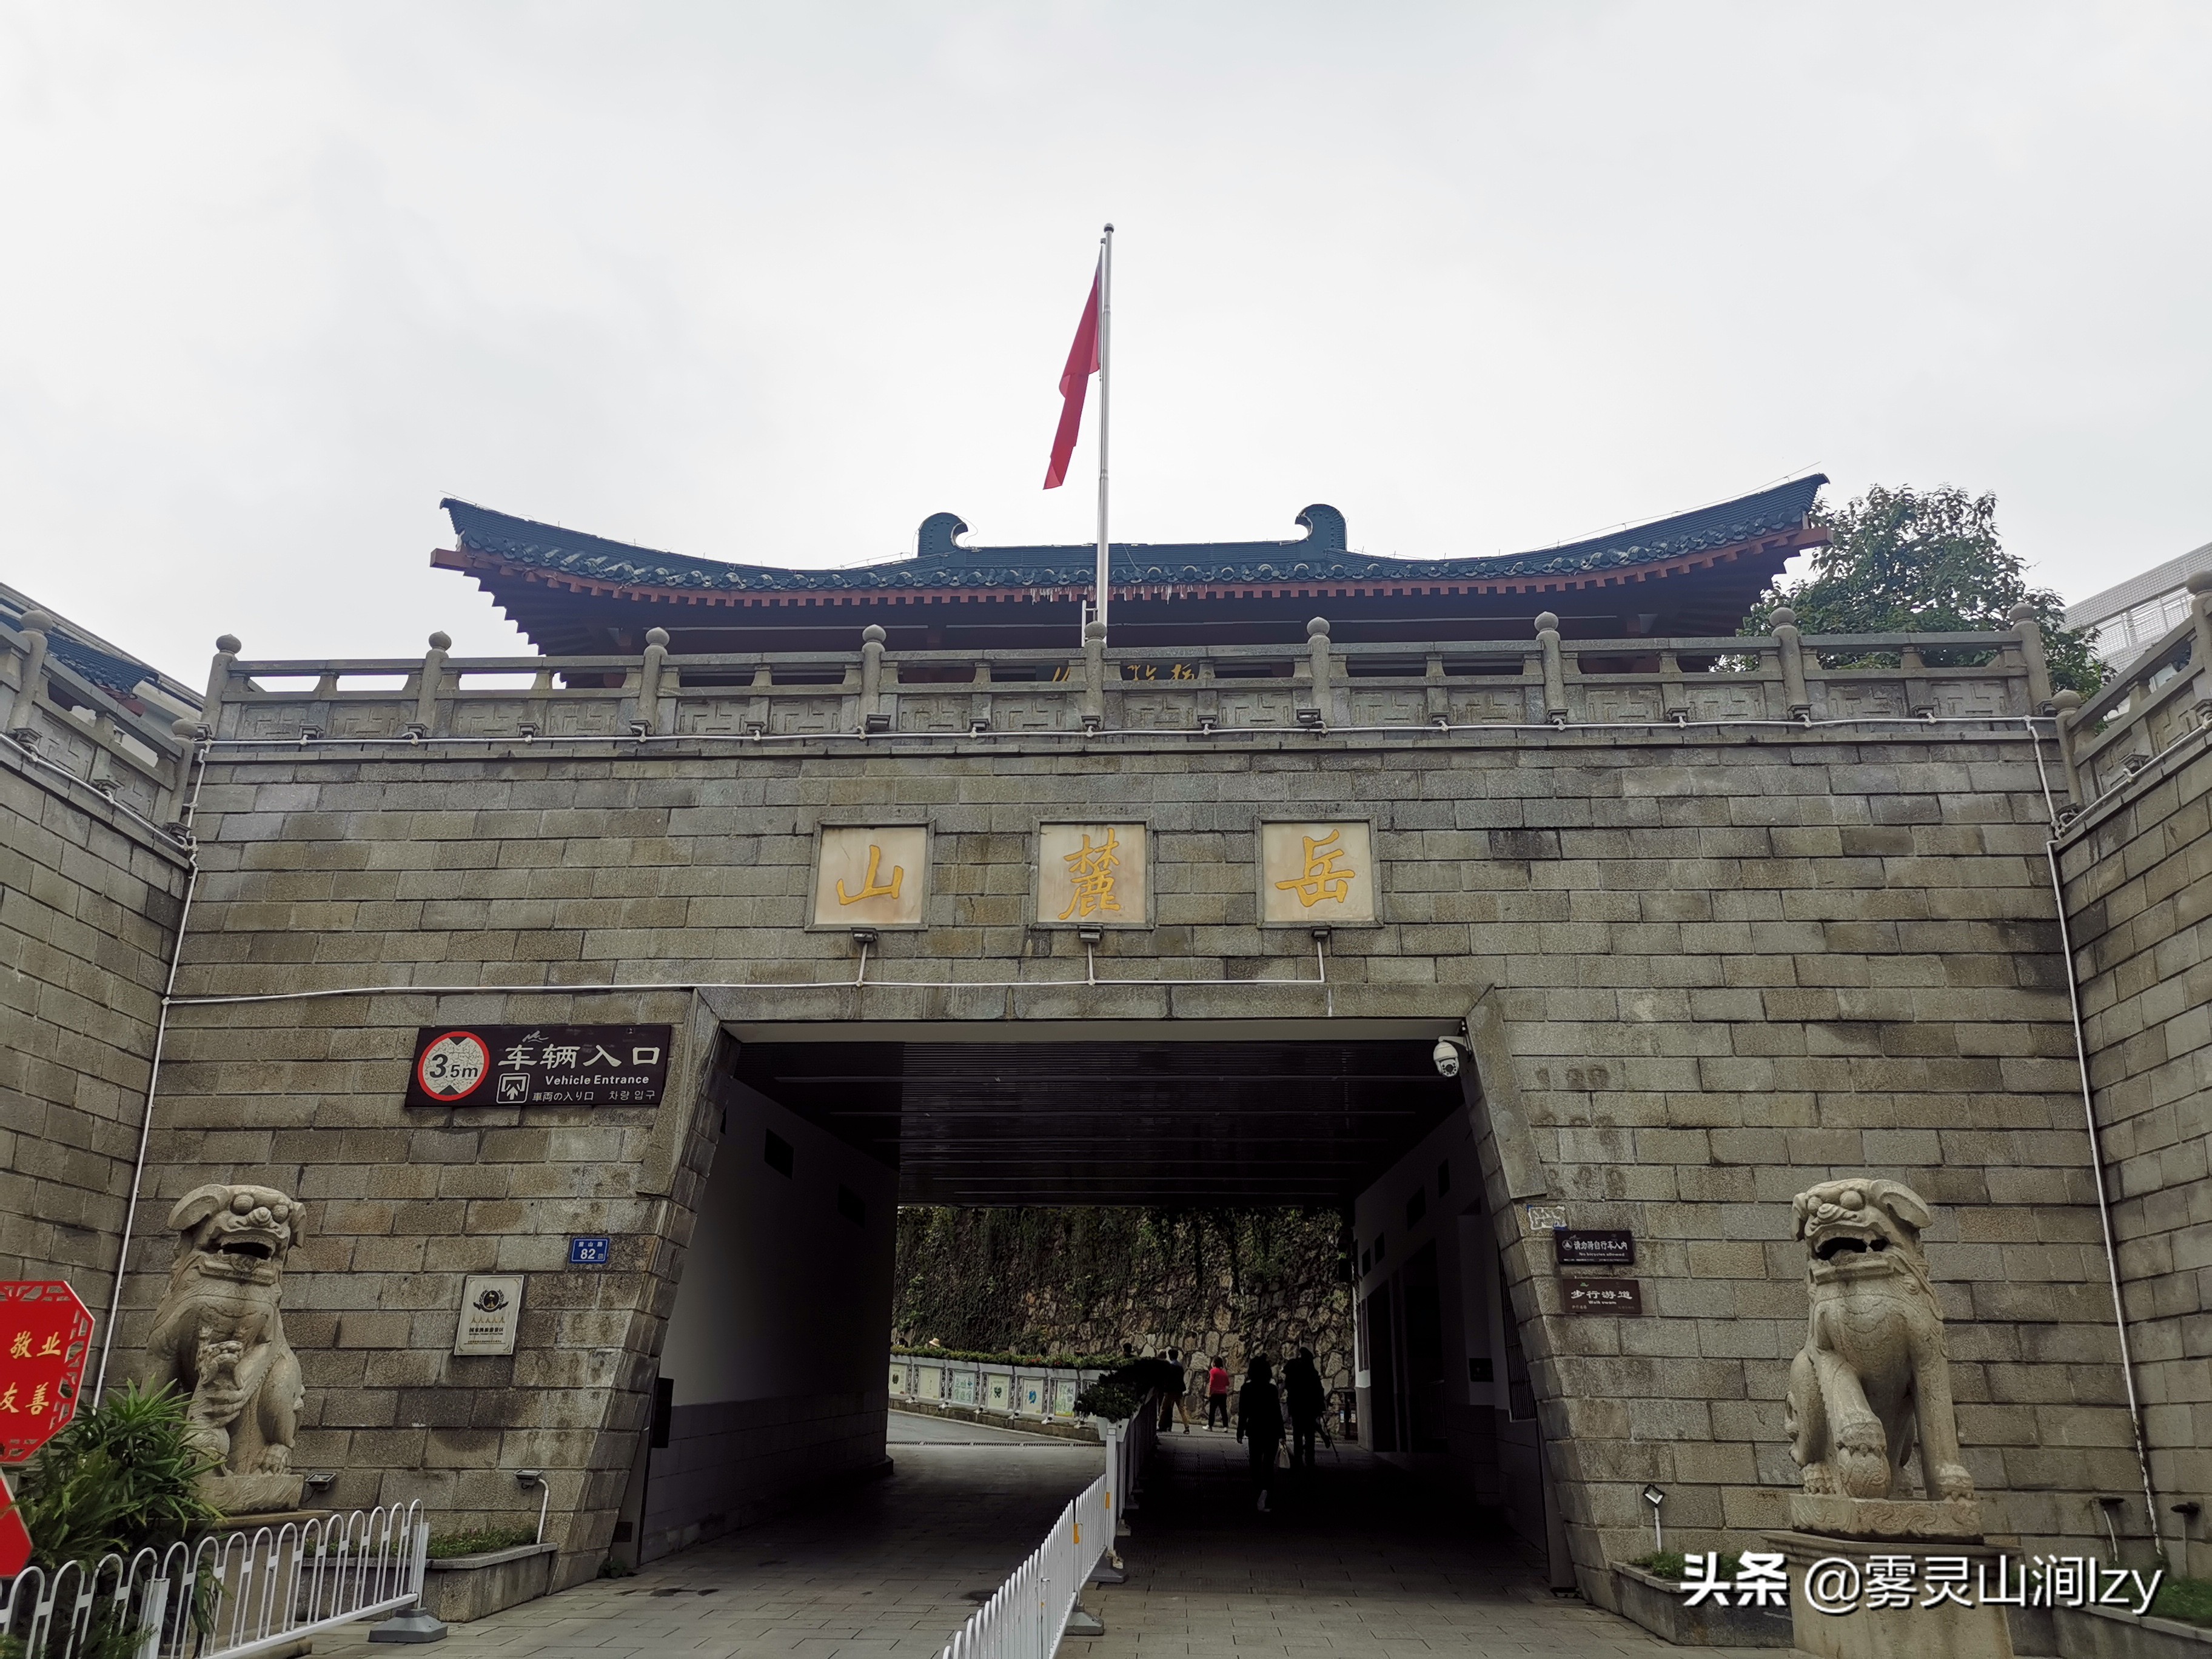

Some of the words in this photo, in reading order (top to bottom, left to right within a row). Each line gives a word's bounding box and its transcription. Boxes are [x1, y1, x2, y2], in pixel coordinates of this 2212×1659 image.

[429, 1053, 479, 1079] 3.5m
[498, 1044, 660, 1071] 车辆入口
[545, 1074, 591, 1086] Vehicle
[594, 1074, 649, 1085] Entrance
[580, 1248, 596, 1259] 82
[1570, 1290, 1633, 1299] 步行游道
[10, 1331, 61, 1359] 敬业
[0, 1381, 50, 1416] 友善
